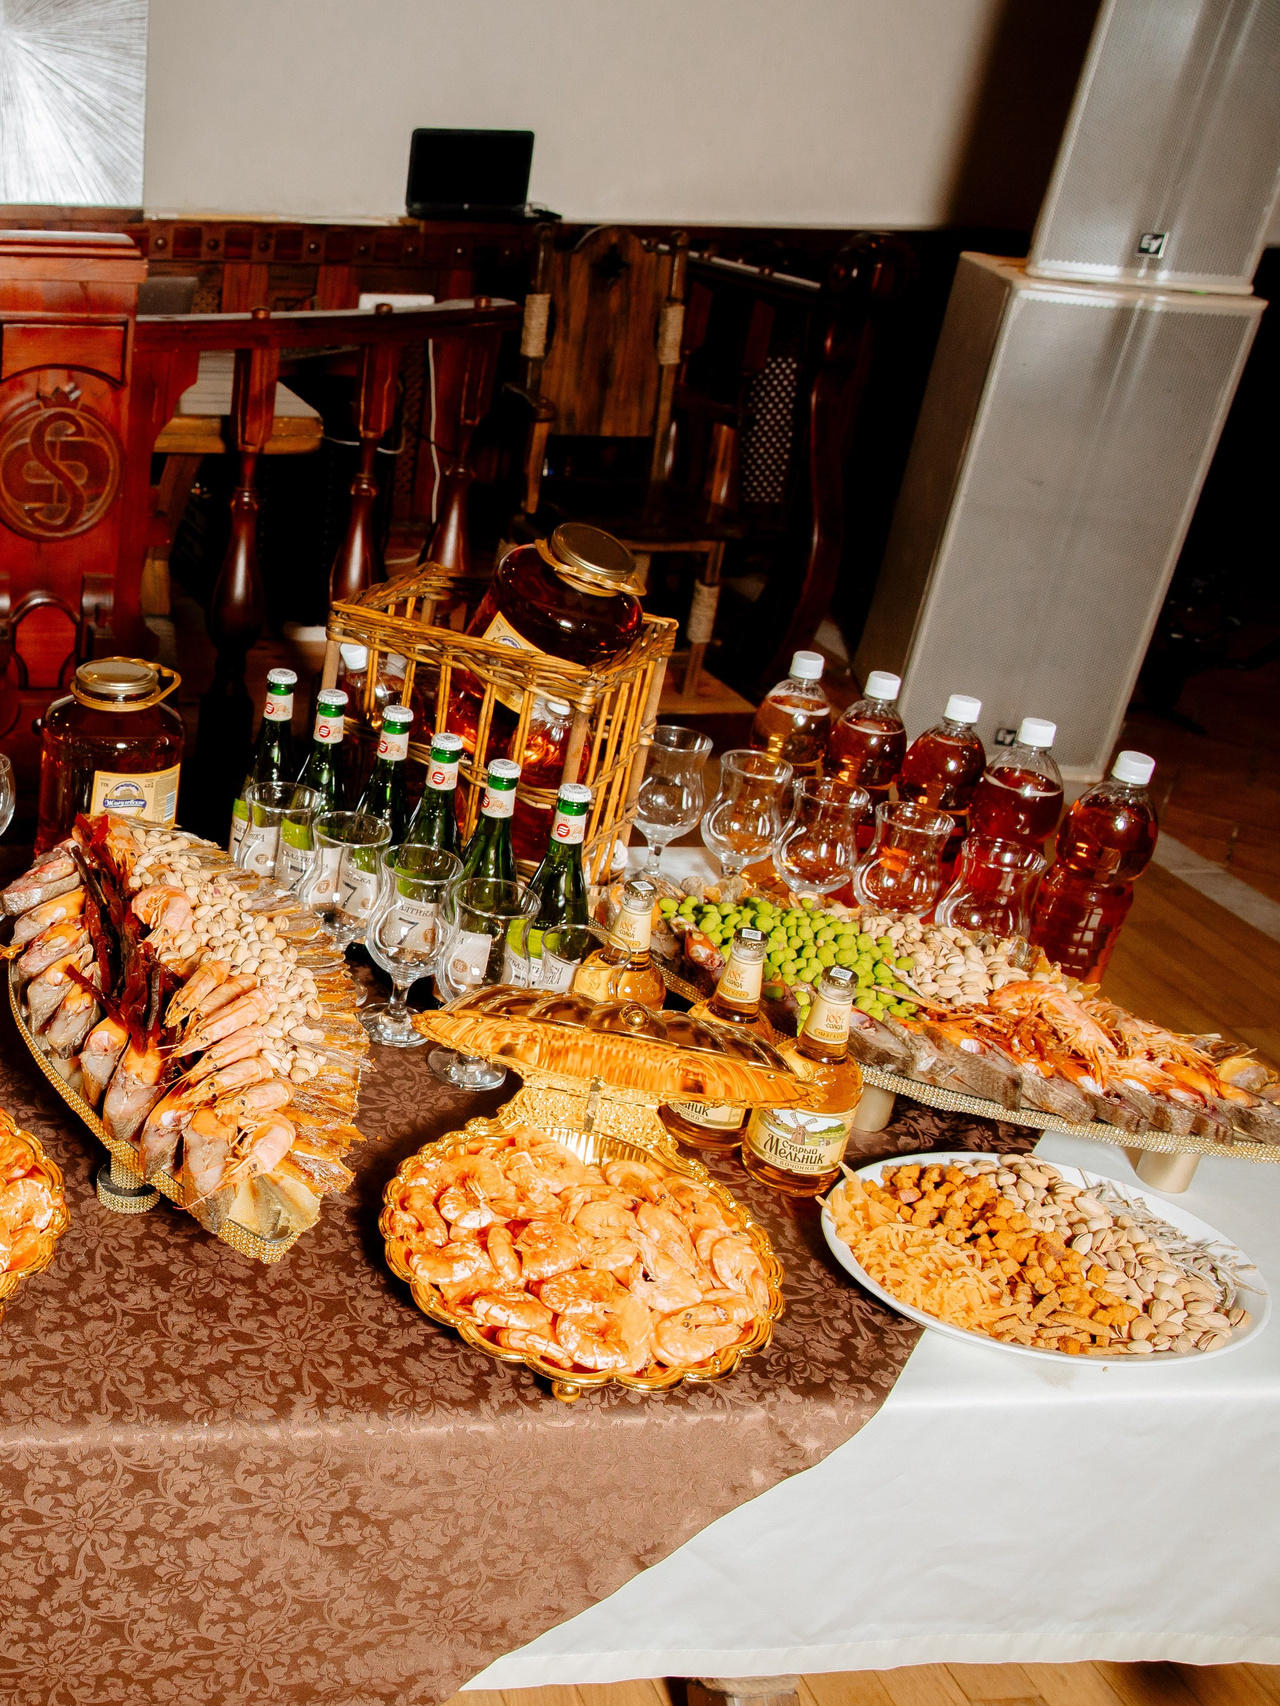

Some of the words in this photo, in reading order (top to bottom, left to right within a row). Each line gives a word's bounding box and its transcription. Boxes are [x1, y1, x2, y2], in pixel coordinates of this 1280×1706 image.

[342, 880, 357, 909] 7
[399, 904, 435, 918] АЛТИКА
[397, 917, 419, 946] 7
[763, 1134, 825, 1164] Мельник
[782, 1140, 818, 1156] Старый
